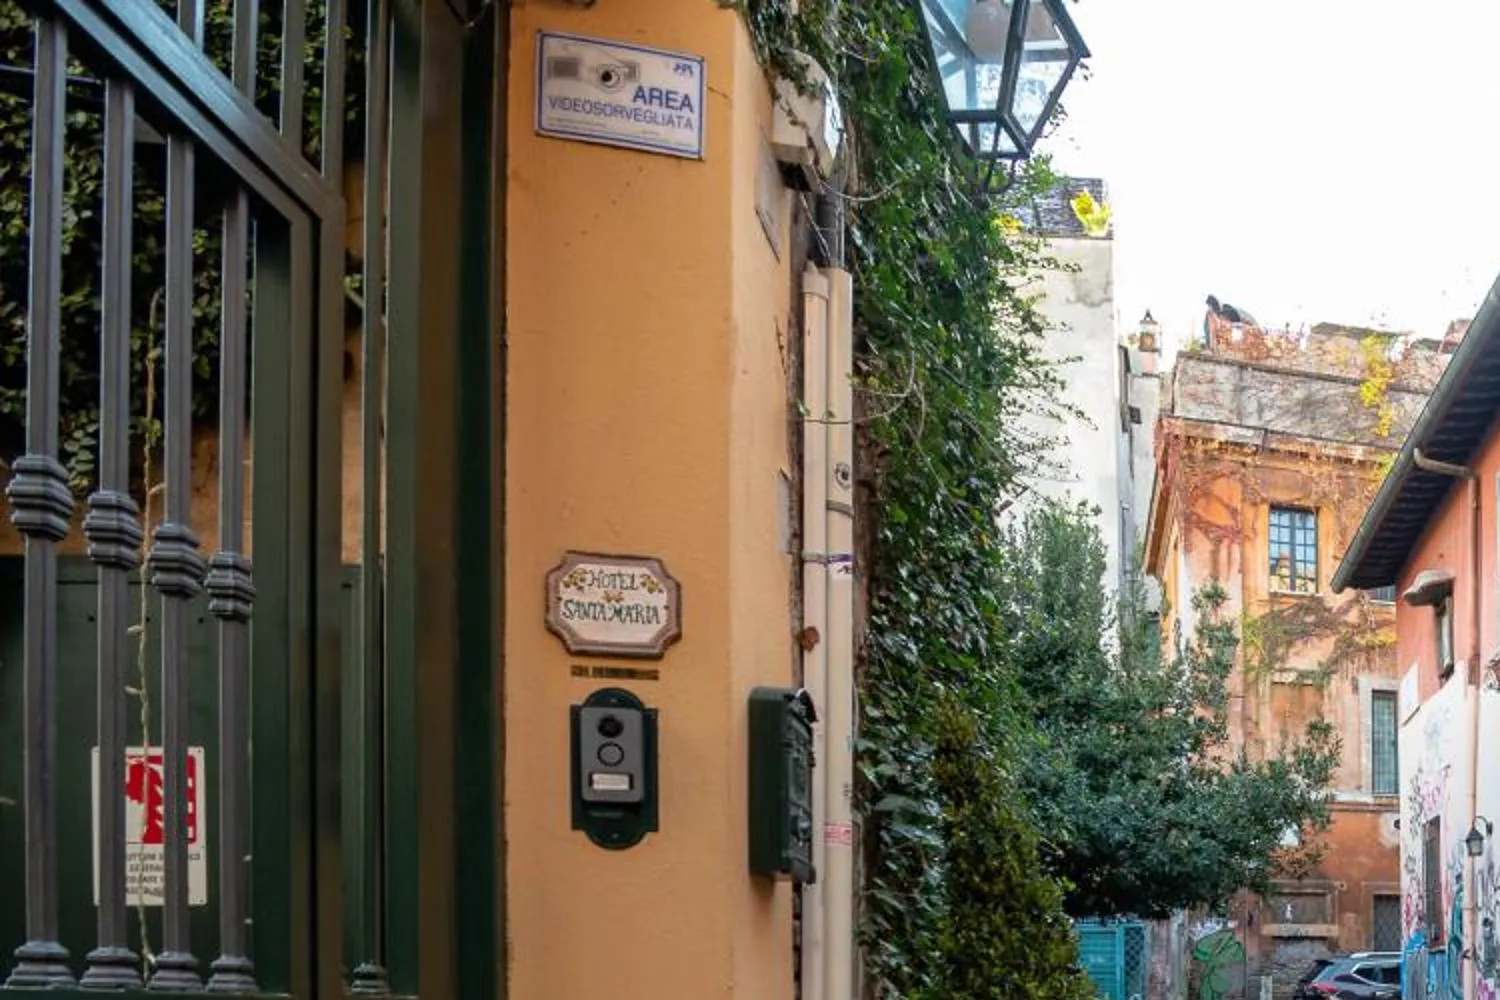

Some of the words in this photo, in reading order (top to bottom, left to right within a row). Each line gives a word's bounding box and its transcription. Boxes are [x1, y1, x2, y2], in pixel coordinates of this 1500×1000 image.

[548, 97, 694, 130] VIDEOSORVEGLIATA
[633, 85, 694, 114] AREA
[607, 602, 661, 625] MARIA
